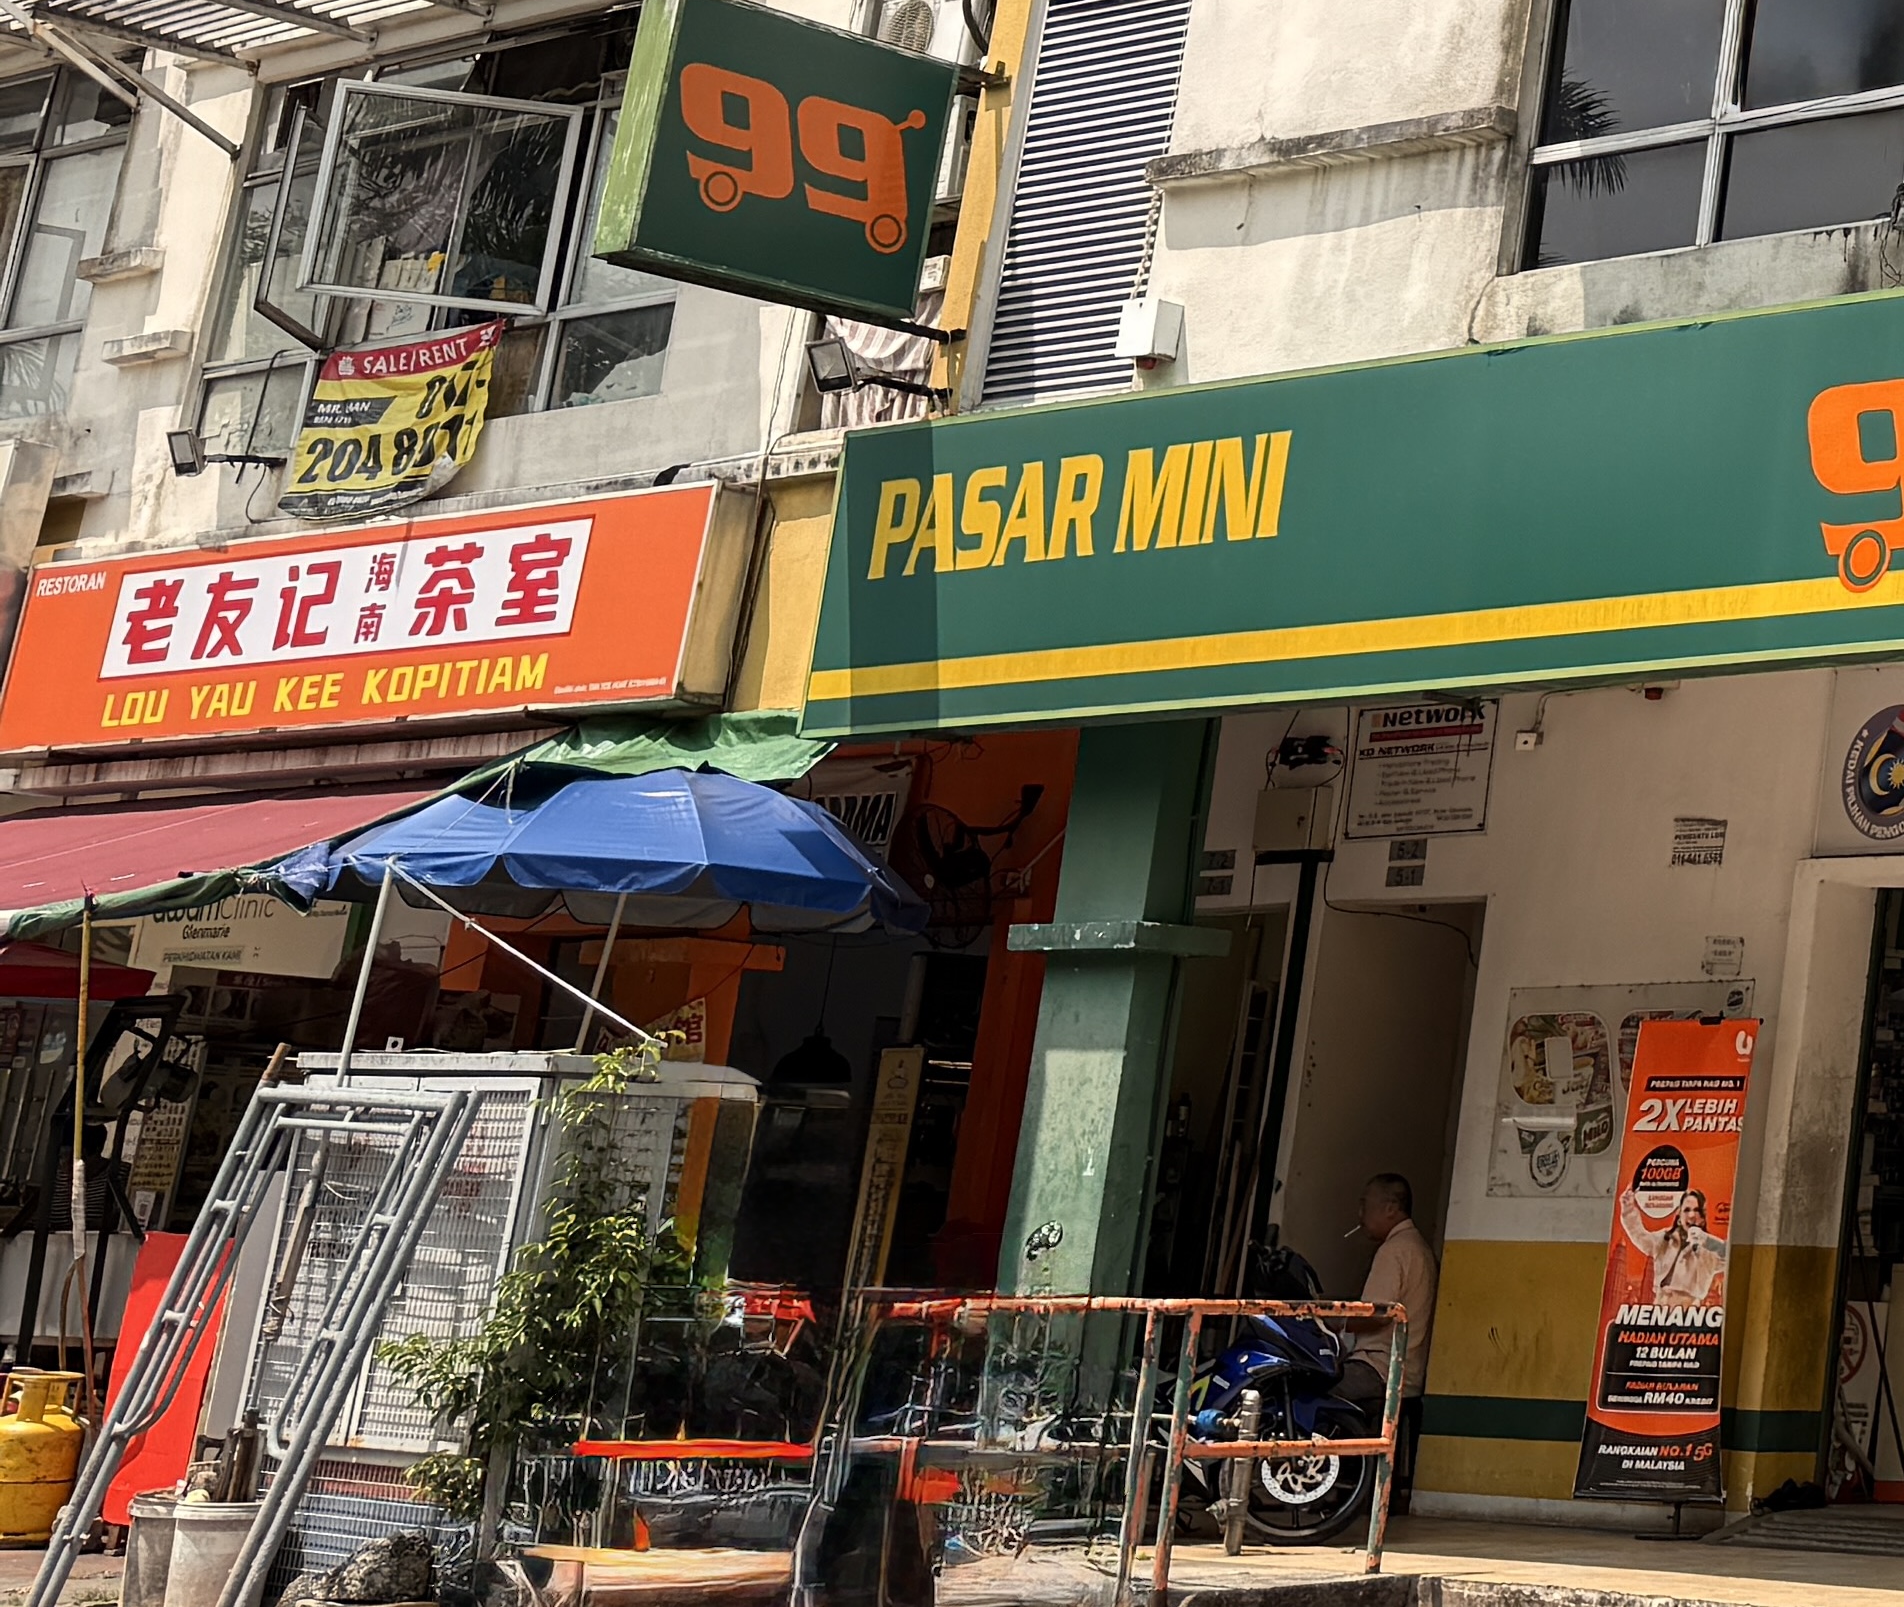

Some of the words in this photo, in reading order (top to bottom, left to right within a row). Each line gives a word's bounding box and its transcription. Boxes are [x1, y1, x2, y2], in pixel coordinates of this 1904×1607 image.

[680, 62, 926, 254] 99
[363, 337, 469, 374] SALE/RENT
[867, 452, 1104, 580] PASAR
[1113, 430, 1293, 554] MINI
[36, 570, 107, 598] RESTORAN
[121, 560, 342, 665] 老友记
[353, 552, 397, 644] 海南
[409, 532, 572, 637] 茶室
[102, 689, 168, 727] LOU
[190, 681, 257, 720] YAU
[273, 672, 341, 712] KEE
[361, 652, 549, 705] KOPITIAM
[1845, 739, 1864, 784] KEDAI
[1632, 1097, 1687, 1133] 2X
[1684, 1098, 1739, 1114] LEBIH
[1682, 1116, 1745, 1133] PANTAS
[1615, 1303, 1724, 1328] MENANG
[1618, 1330, 1666, 1344] HADIAH
[1668, 1331, 1720, 1346] UTAMA
[1635, 1346, 1650, 1359] 12
[1650, 1347, 1698, 1360] BULAN
[1643, 1392, 1685, 1405] RM40
[1598, 1444, 1659, 1457] RANGKAIAN
[1693, 1442, 1713, 1462] 5G
[1621, 1459, 1635, 1470] DI
[1635, 1460, 1686, 1472] MALAYSIA
